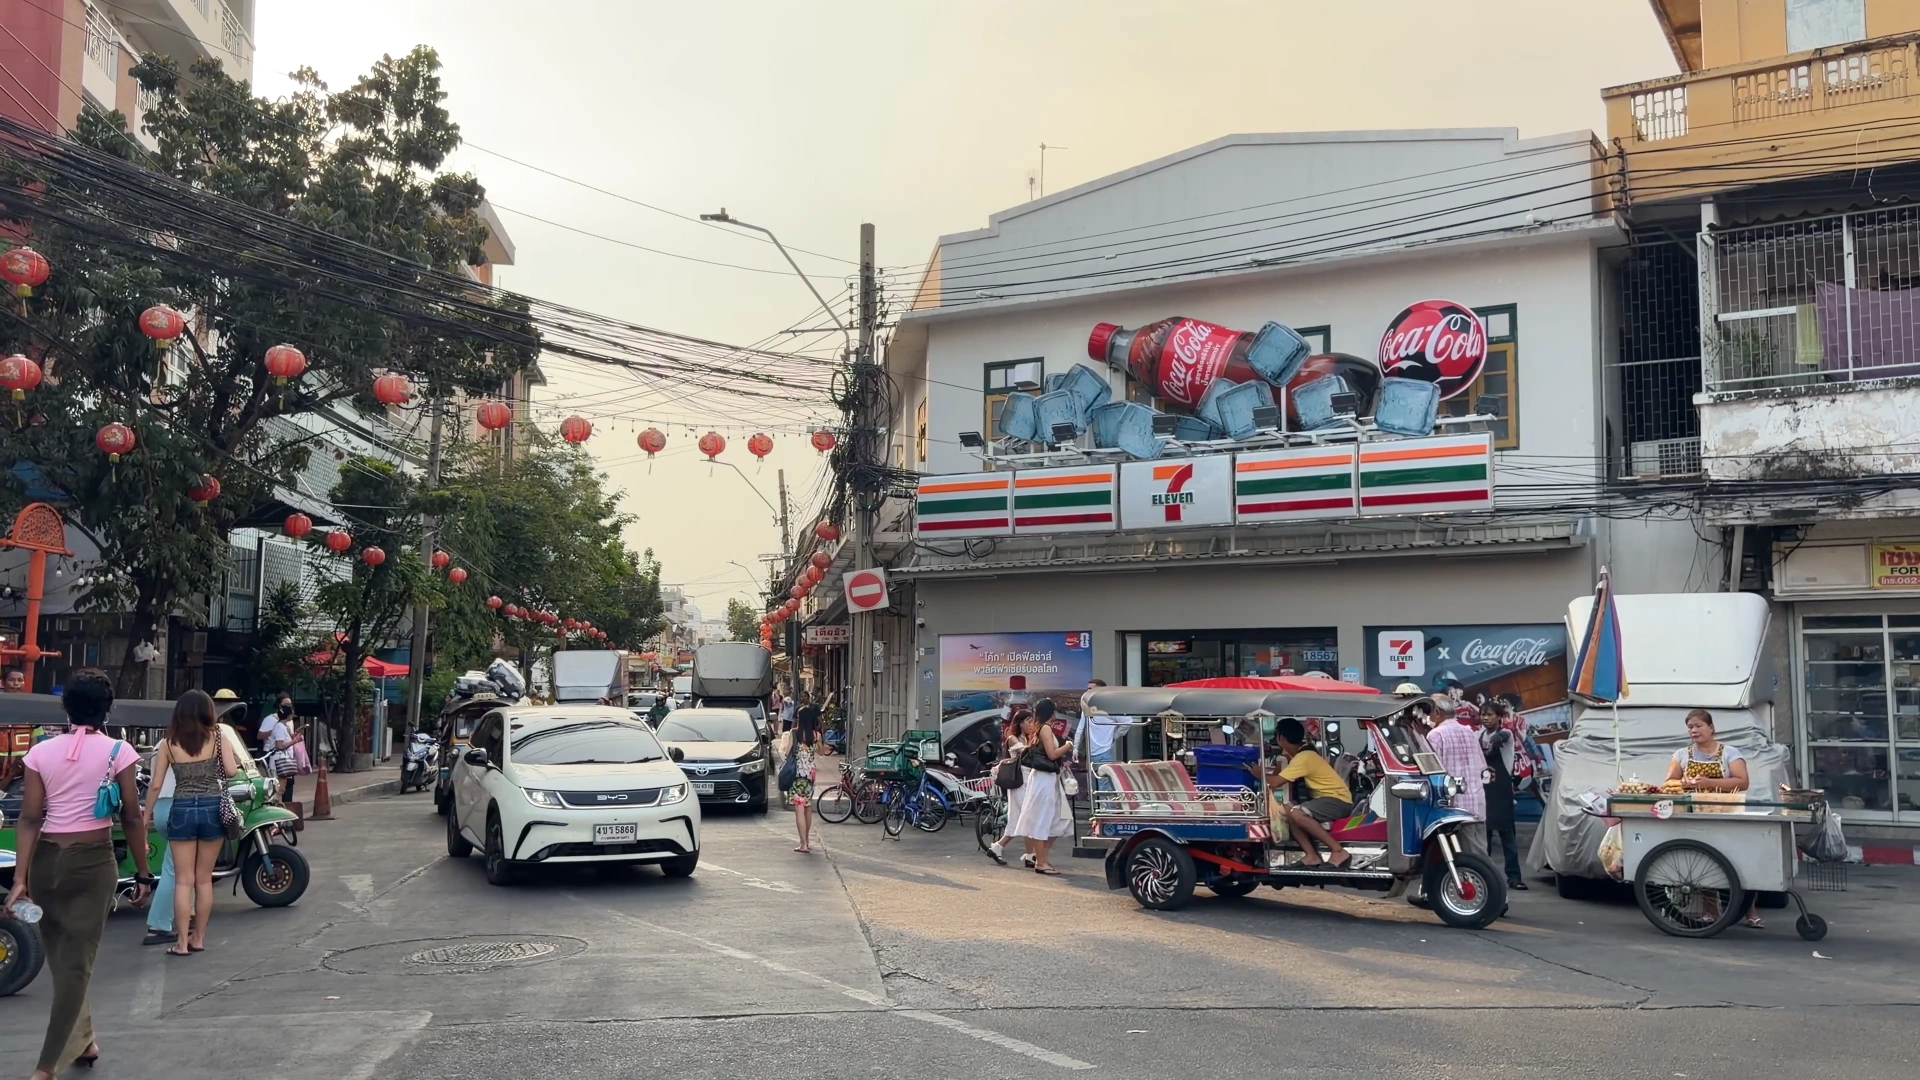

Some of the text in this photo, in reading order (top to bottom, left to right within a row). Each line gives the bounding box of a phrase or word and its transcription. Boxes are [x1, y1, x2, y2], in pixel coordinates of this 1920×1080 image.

[1380, 314, 1481, 373] Coca-Cola
[1162, 320, 1212, 403] Coca-Cola
[1891, 567, 1919, 575] FOR
[1304, 651, 1336, 660] 18567
[1461, 638, 1550, 666] Coca-Cola
[616, 825, 635, 835] 5868
